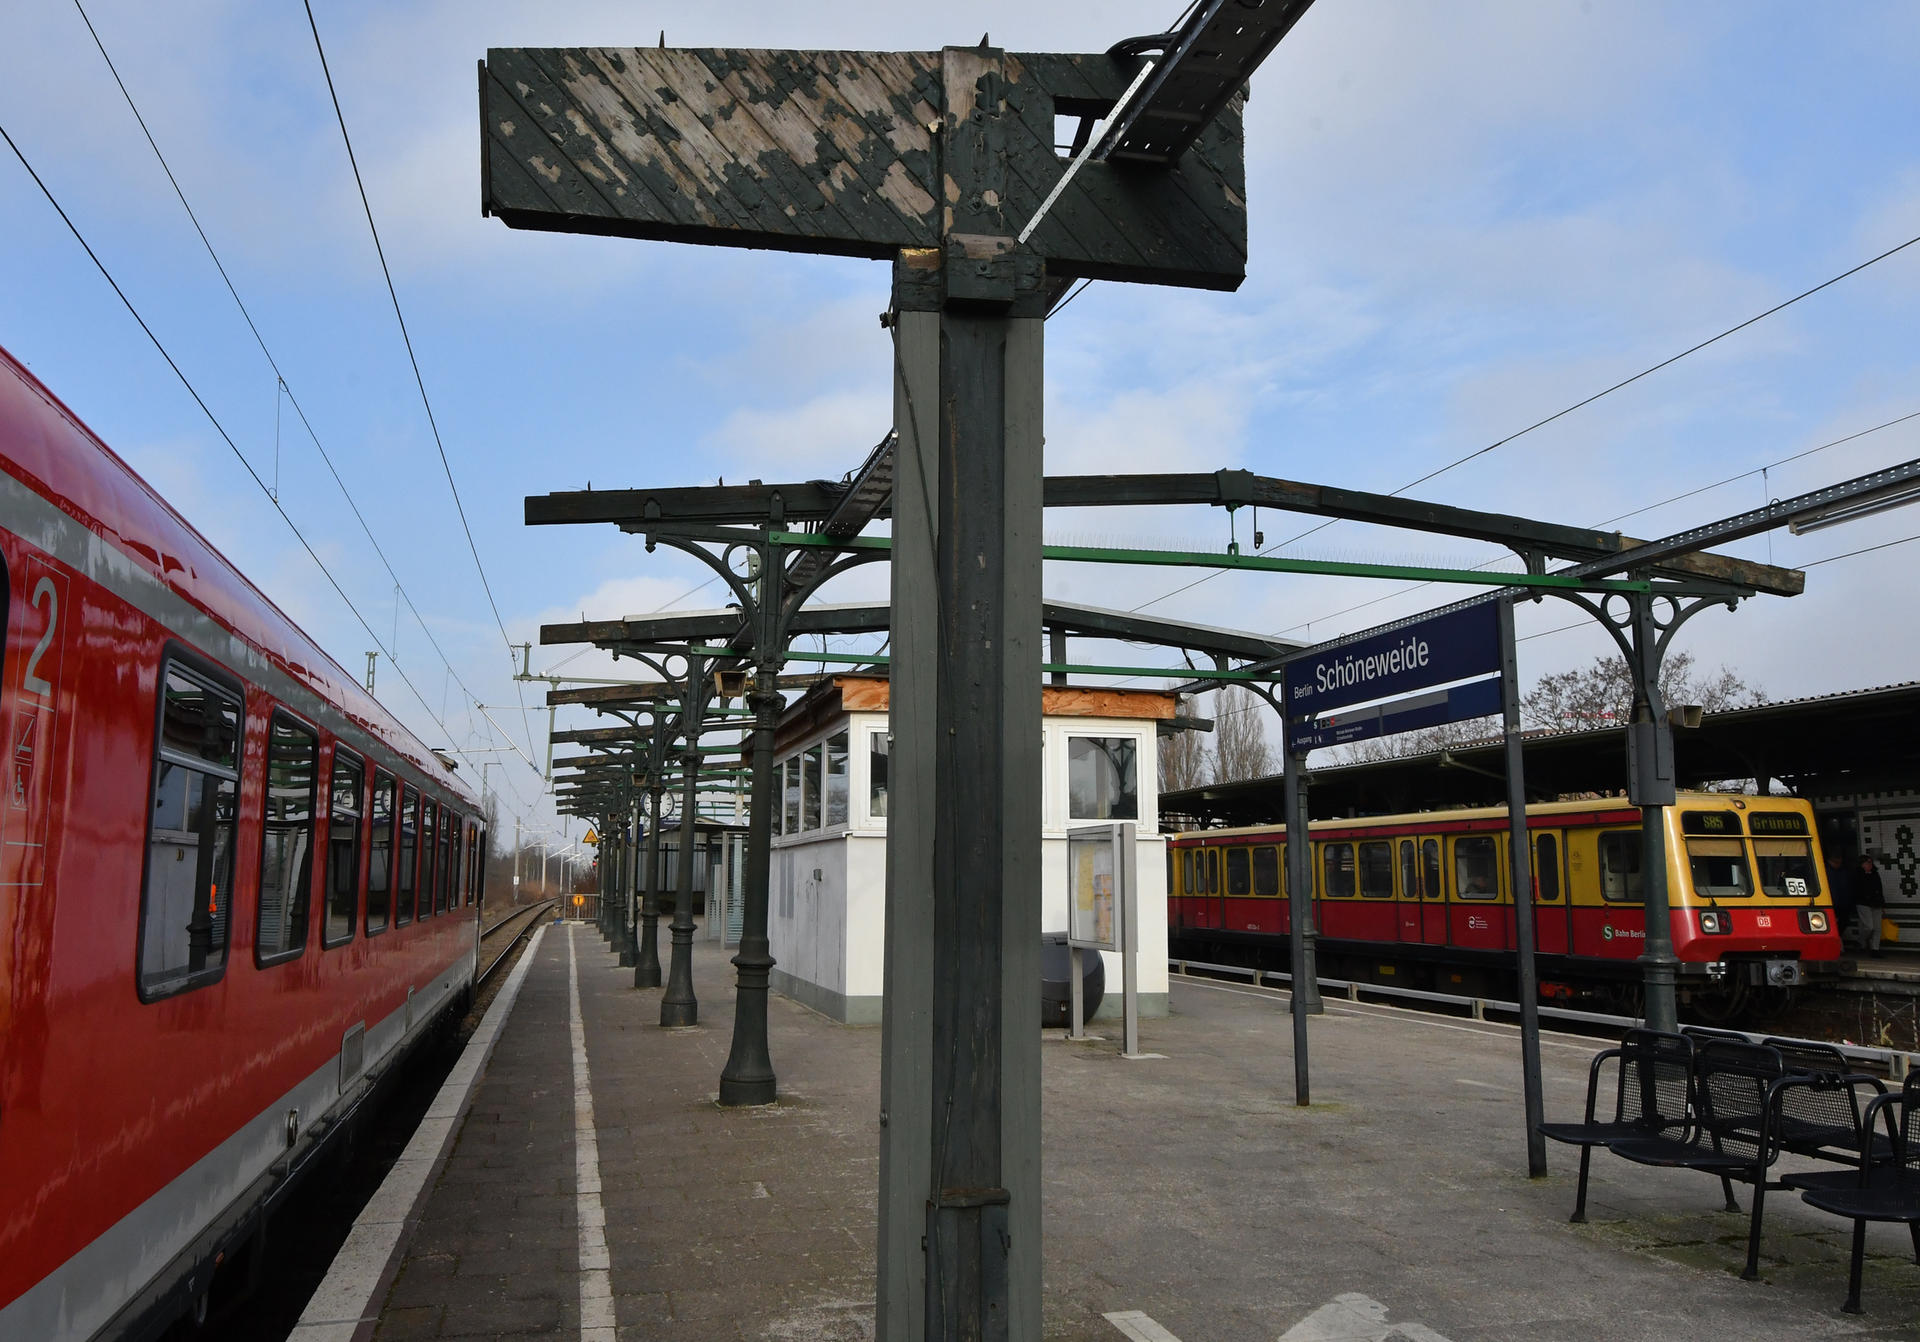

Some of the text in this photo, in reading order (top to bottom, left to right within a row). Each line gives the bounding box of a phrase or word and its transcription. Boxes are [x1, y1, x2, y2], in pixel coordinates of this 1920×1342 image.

[24, 576, 58, 697] 2
[1294, 636, 1429, 700] Berlin Schöneweide
[1703, 814, 1800, 830] S85 Grünau
[1788, 881, 1806, 894] 55
[1759, 917, 1770, 926] DB
[1604, 926, 1612, 939] S
[1615, 929, 1629, 937] Bahn
